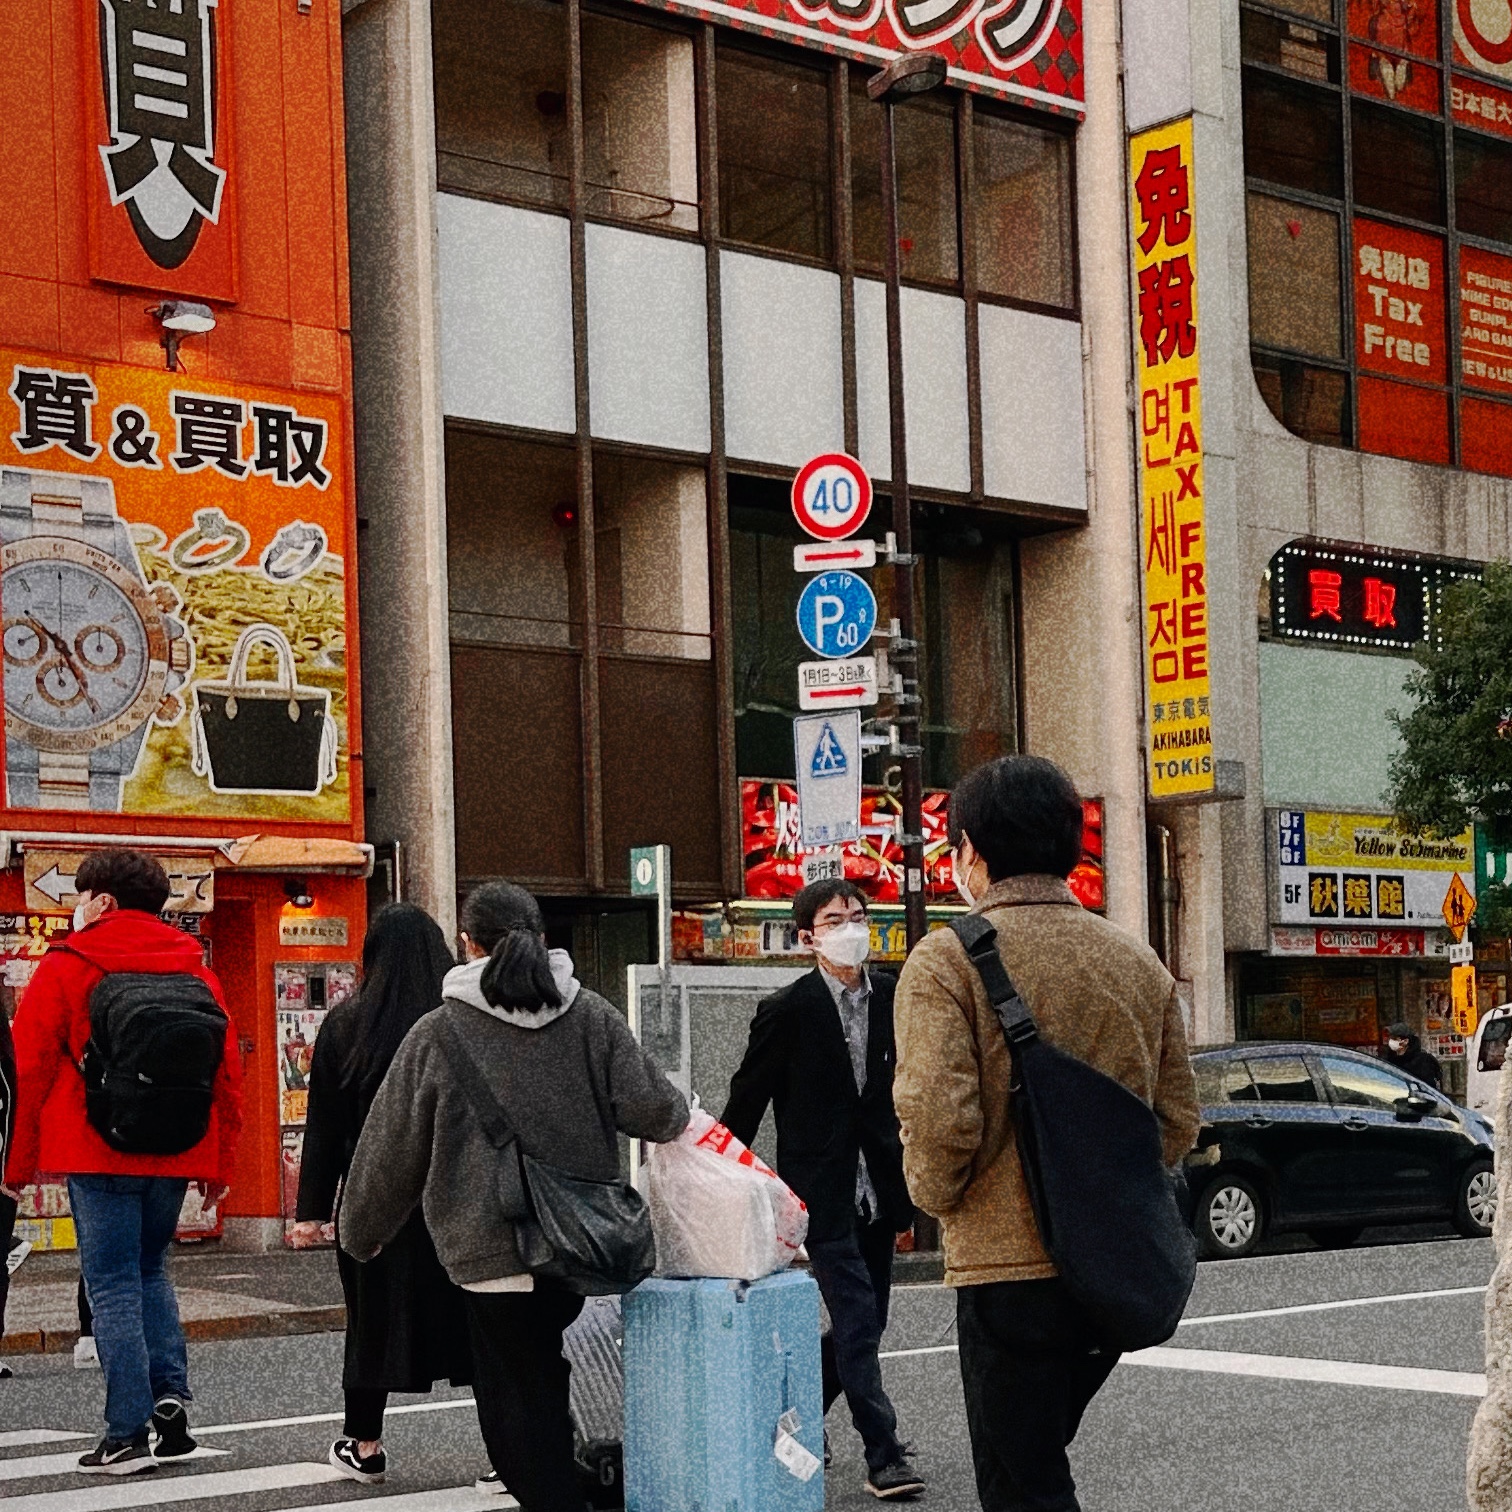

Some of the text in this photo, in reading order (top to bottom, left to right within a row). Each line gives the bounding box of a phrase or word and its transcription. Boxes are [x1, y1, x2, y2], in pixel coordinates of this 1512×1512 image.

[1135, 145, 1196, 367] 免税
[1359, 245, 1430, 290] 免税店
[1367, 285, 1424, 327] Tax
[1461, 288, 1491, 307] NIME
[1363, 324, 1431, 367] Free
[1461, 326, 1490, 343] ARD
[811, 477, 854, 515] 40
[1179, 521, 1208, 681] FREE
[1309, 569, 1396, 629] 買取
[815, 595, 845, 650] P
[1152, 696, 1210, 724] 東京電気
[1153, 725, 1212, 751] AKIHABARA
[1280, 811, 1300, 828] 8F
[1281, 829, 1300, 846] 7F
[1354, 836, 1468, 860] Yellow Submarine
[1281, 847, 1300, 864] 6F
[1284, 884, 1302, 904] 5F
[1310, 876, 1405, 917] 秋葉館
